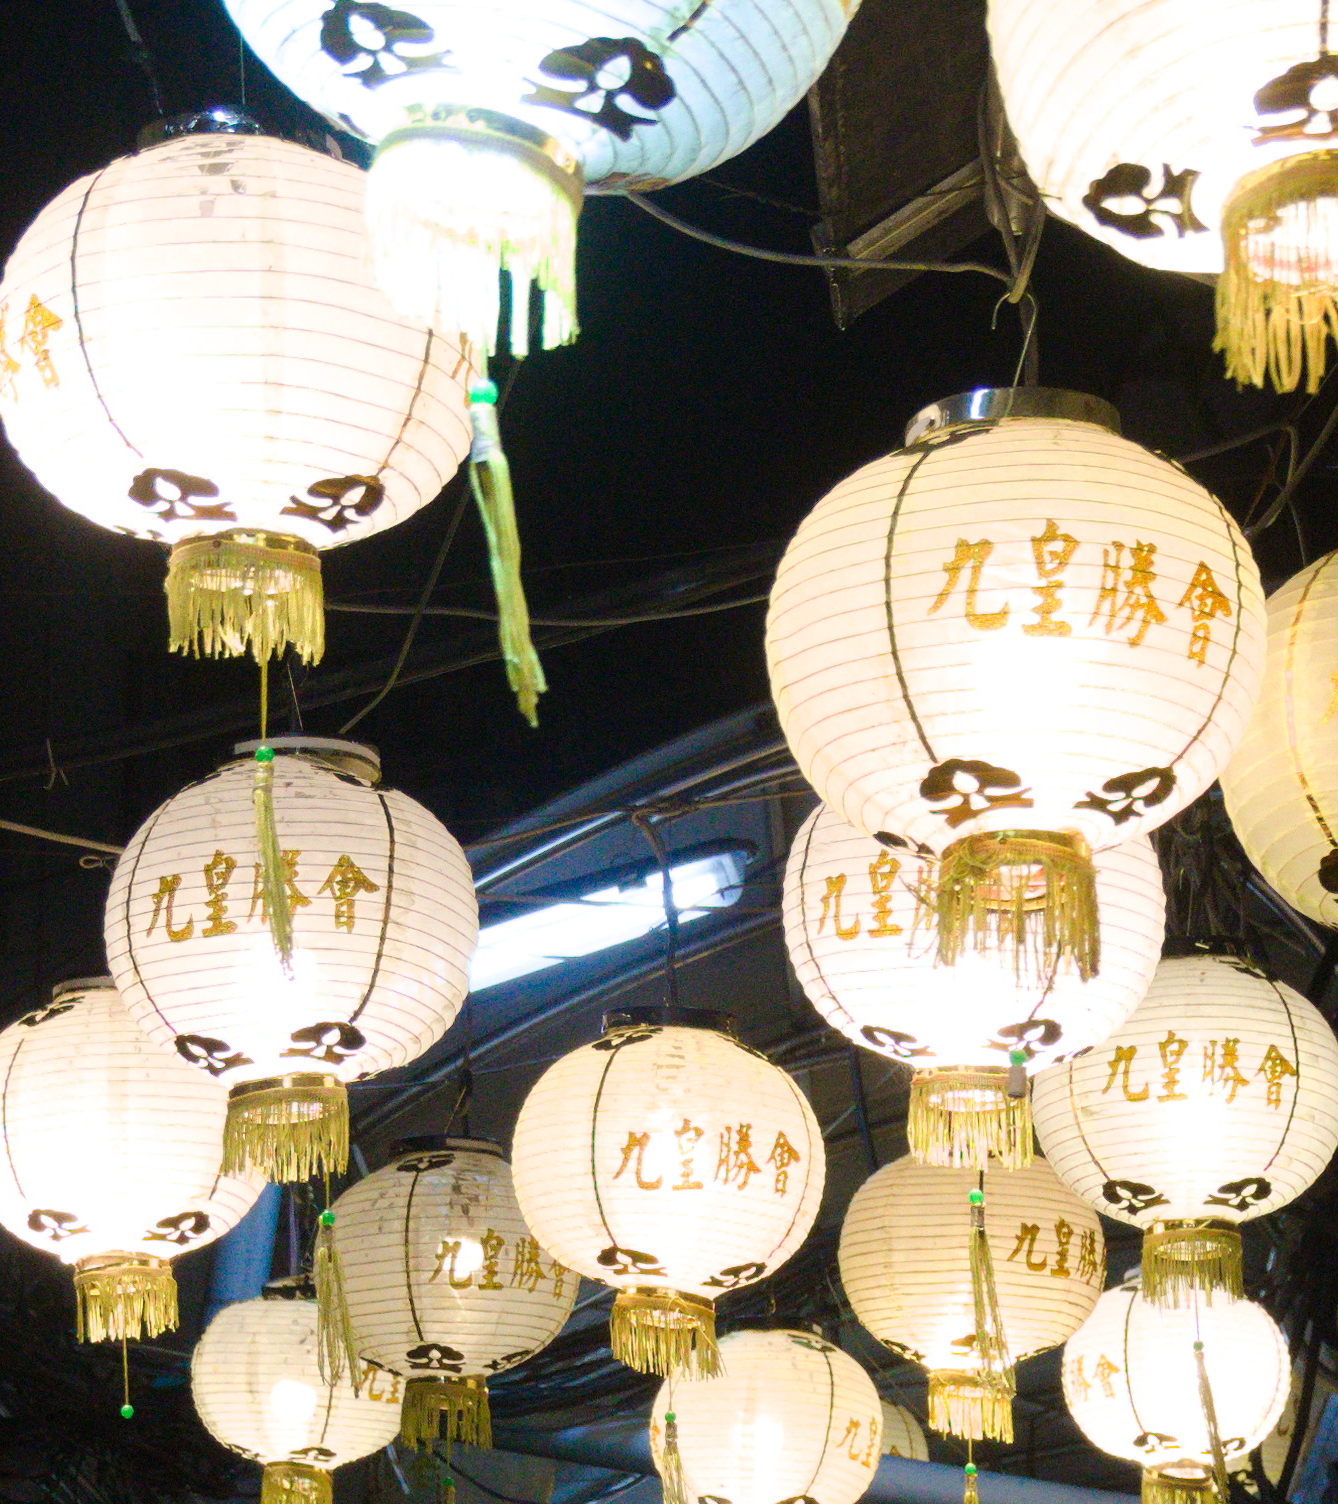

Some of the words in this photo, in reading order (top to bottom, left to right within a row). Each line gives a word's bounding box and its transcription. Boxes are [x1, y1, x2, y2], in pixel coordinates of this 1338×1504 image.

[926, 518, 1233, 669] 九皇勝會
[1101, 1030, 1298, 1112] 九皇勝會
[614, 1118, 801, 1198] 九皇勝會
